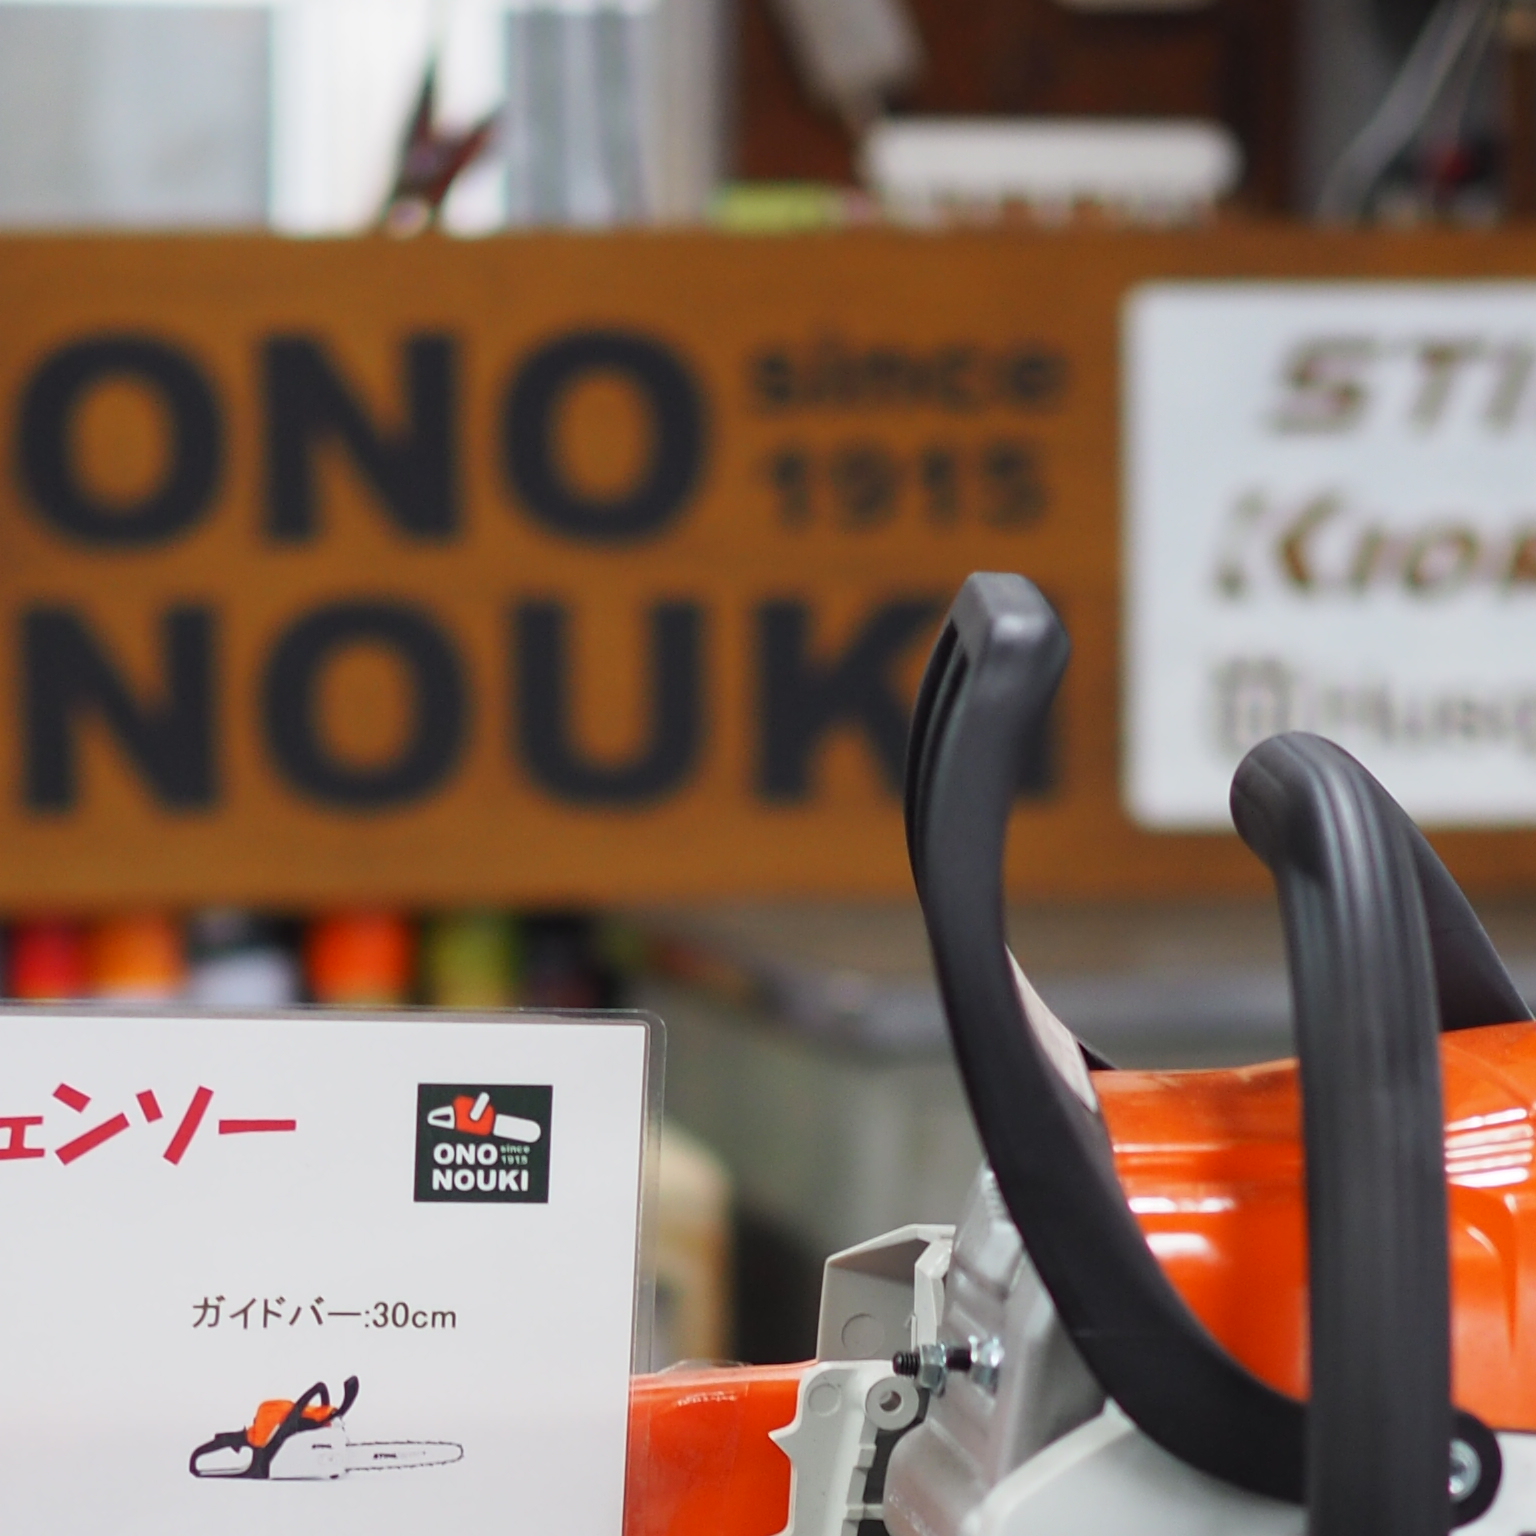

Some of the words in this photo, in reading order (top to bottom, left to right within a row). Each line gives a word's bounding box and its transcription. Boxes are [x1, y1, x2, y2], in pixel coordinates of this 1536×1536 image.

[9, 325, 716, 552] ONO
[754, 328, 1069, 412] since
[433, 1142, 498, 1166] ONO
[500, 1144, 531, 1154] since
[432, 1168, 529, 1192] NOUKI
